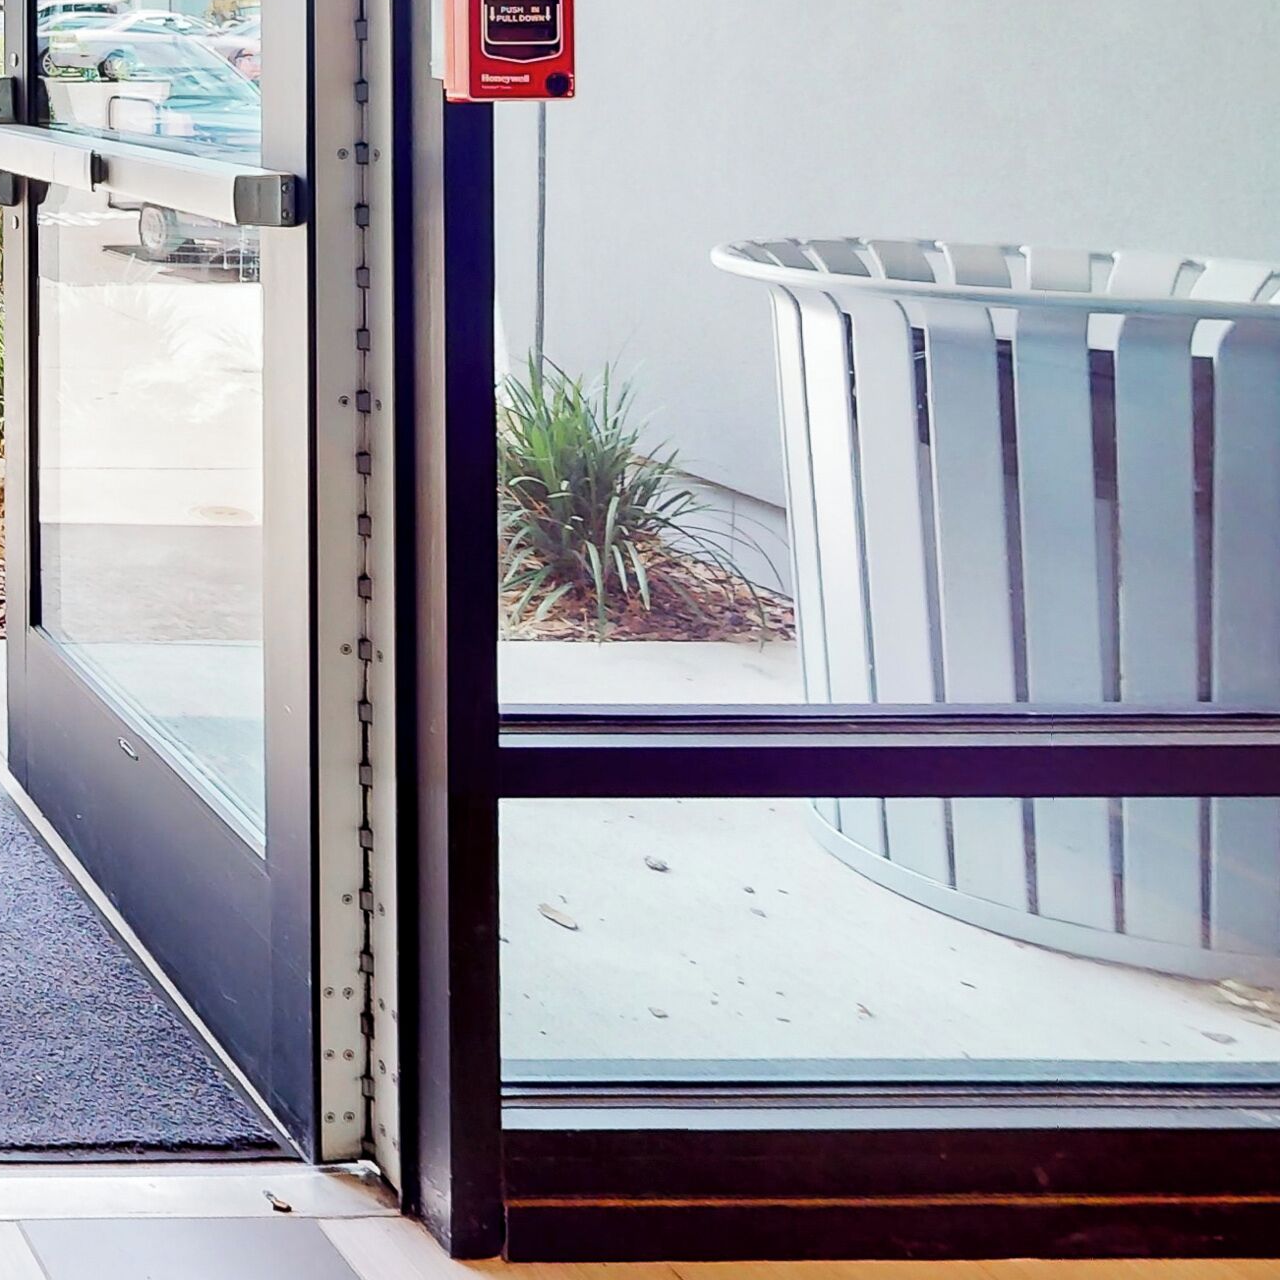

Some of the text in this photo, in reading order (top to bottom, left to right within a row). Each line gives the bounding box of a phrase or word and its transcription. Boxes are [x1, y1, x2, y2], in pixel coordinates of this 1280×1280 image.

[496, 14, 545, 22] PULL DOWN
[481, 73, 530, 84] Honeywell
